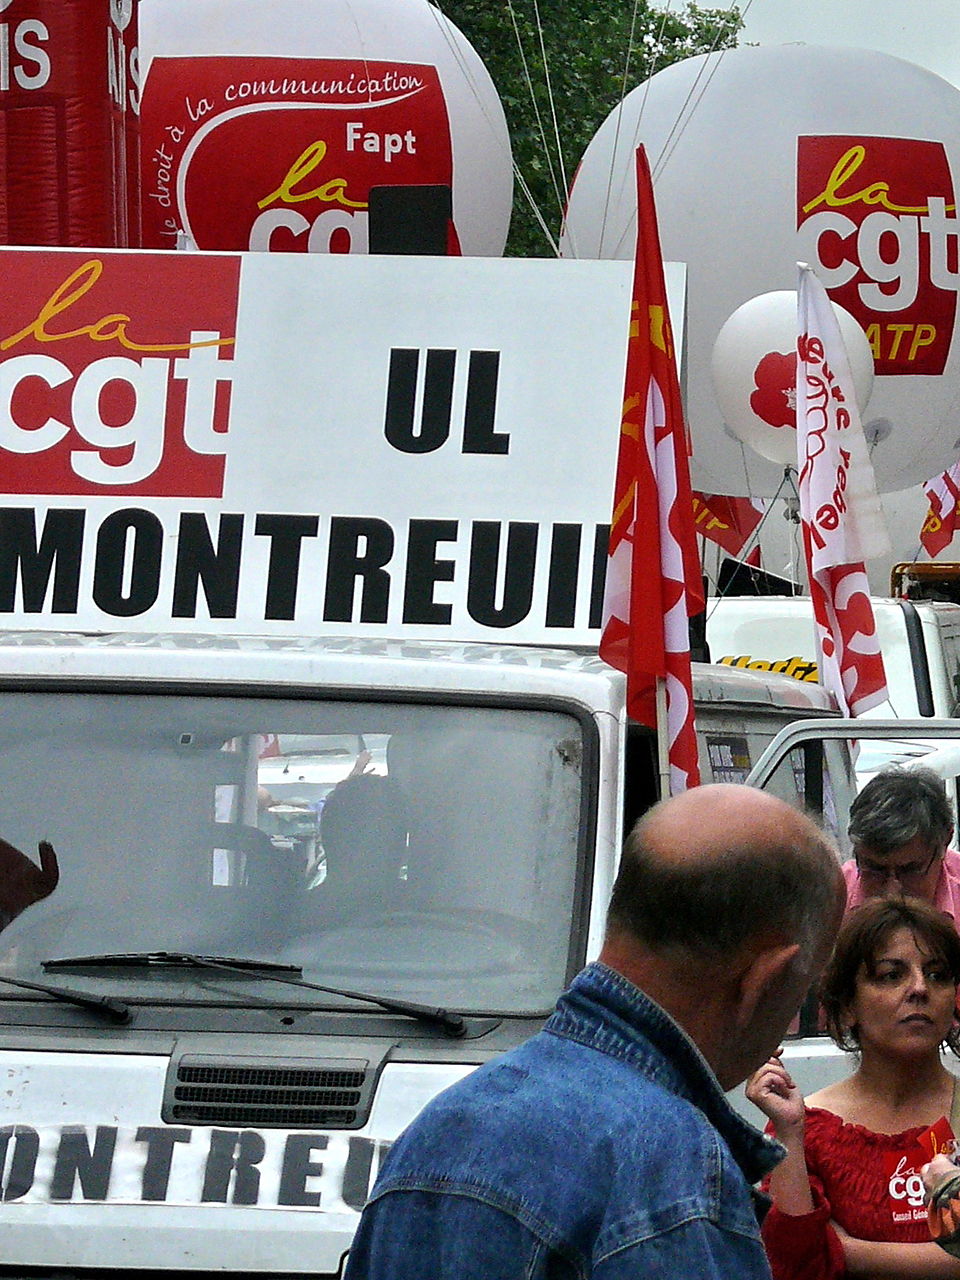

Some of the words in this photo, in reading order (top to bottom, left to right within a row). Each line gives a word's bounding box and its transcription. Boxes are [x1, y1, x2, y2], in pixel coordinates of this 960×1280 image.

[149, 143, 174, 208] droit
[165, 125, 186, 143] à
[186, 96, 215, 122] la
[224, 70, 424, 101] communication
[346, 122, 417, 163] Fapt
[257, 140, 369, 209] la
[802, 145, 956, 214] la
[249, 208, 369, 254] cg
[797, 196, 959, 312] cgt
[0, 259, 235, 352] la
[865, 323, 937, 361] ATP
[0, 331, 235, 485] cgt
[384, 348, 510, 455] UL
[888, 1176, 926, 1207] cg
[889, 1156, 921, 1180] la
